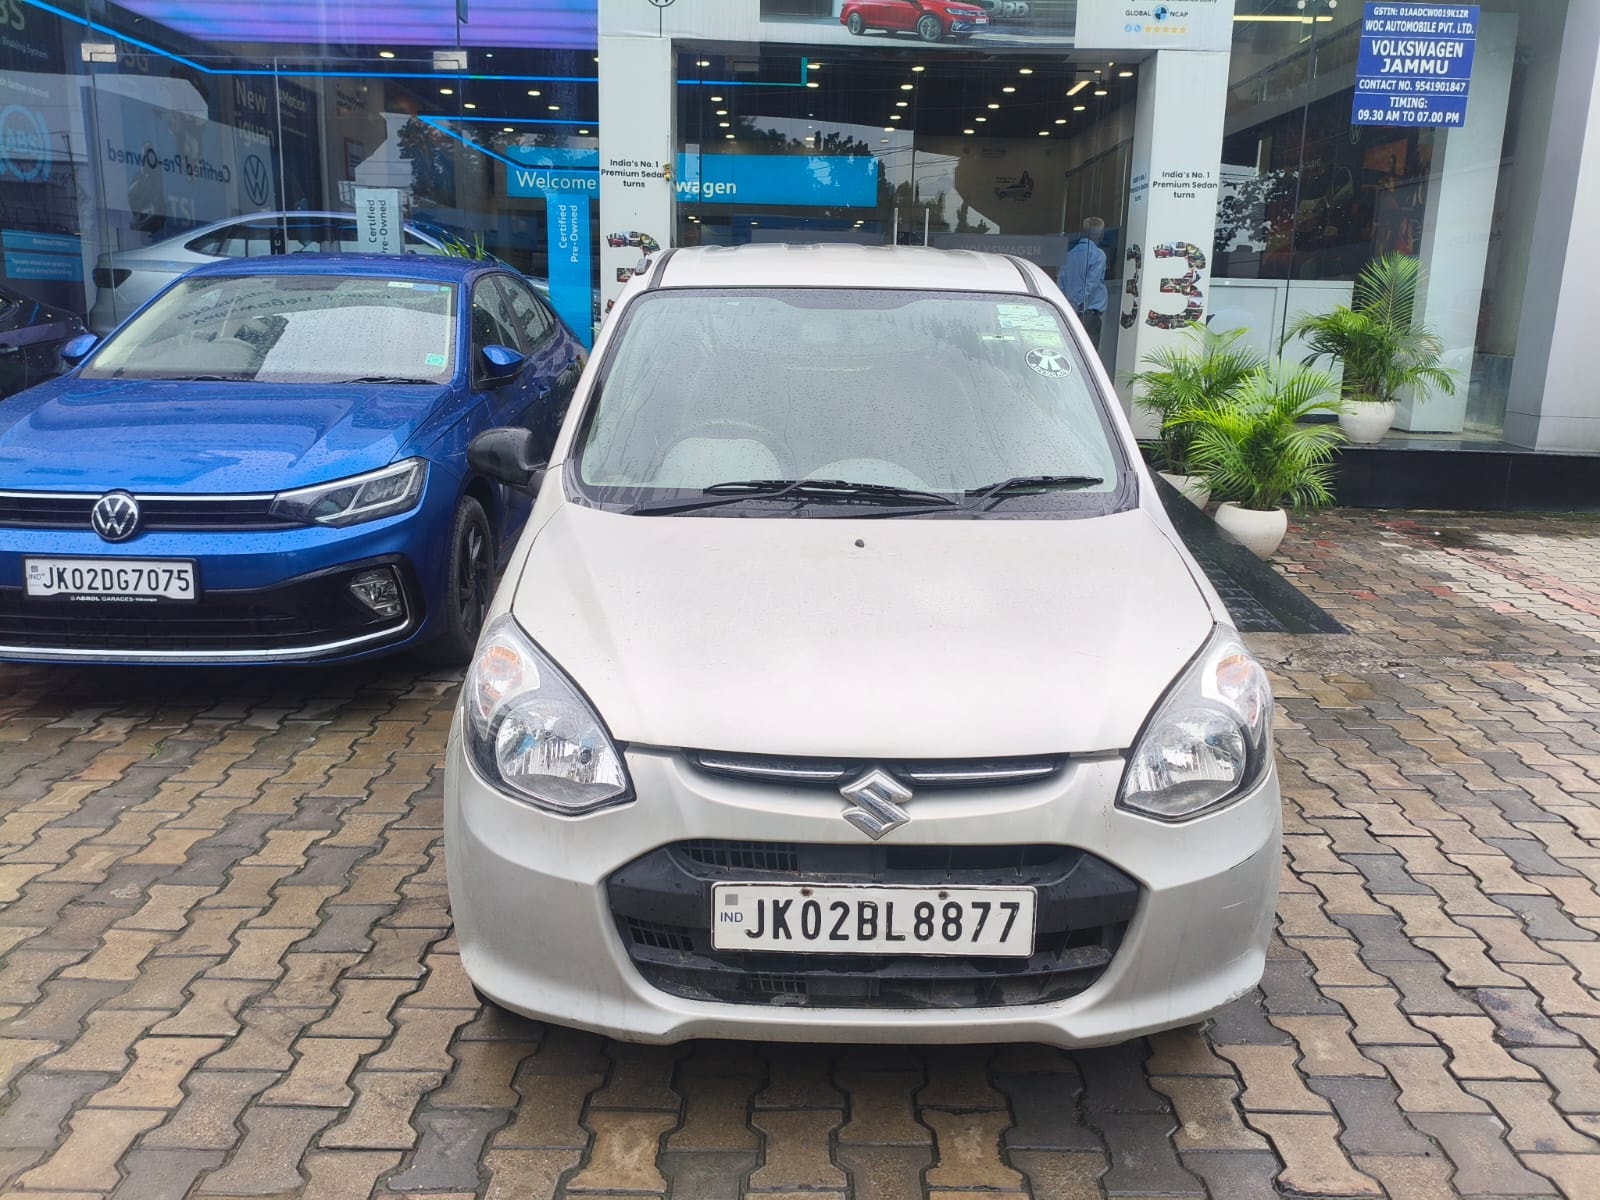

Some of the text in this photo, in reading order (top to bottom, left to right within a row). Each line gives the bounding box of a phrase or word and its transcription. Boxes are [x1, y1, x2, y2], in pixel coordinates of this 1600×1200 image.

[1125, 9, 1151, 17] GLOBAL
[1373, 7, 1399, 16] GSTIN:
[1365, 19, 1474, 34] WOC AUTOMOBILE PVT. LTD.
[1371, 39, 1464, 58] VOLKSWAGEN
[1380, 58, 1449, 74] JAMMU
[1359, 79, 1466, 92] CONTACT NO. 9541901847
[235, 78, 266, 114] New
[1389, 96, 1428, 108] TIMING:
[1357, 109, 1460, 123] 09.30 AM TO 07.00 PM
[610, 159, 638, 167] India's
[640, 160, 653, 168] No.
[601, 168, 640, 177] Premium
[1191, 171, 1204, 179] No.
[516, 170, 597, 190] Welcome
[623, 180, 646, 188] turns
[1152, 180, 1218, 189] Premium Sedan
[1173, 191, 1196, 199] turns
[367, 199, 377, 243] Certified
[558, 204, 568, 249] Certified
[570, 204, 579, 263] Pre-Owned
[43, 566, 190, 592] JK02DG7075
[720, 898, 1020, 943] IND JK02BL8877
